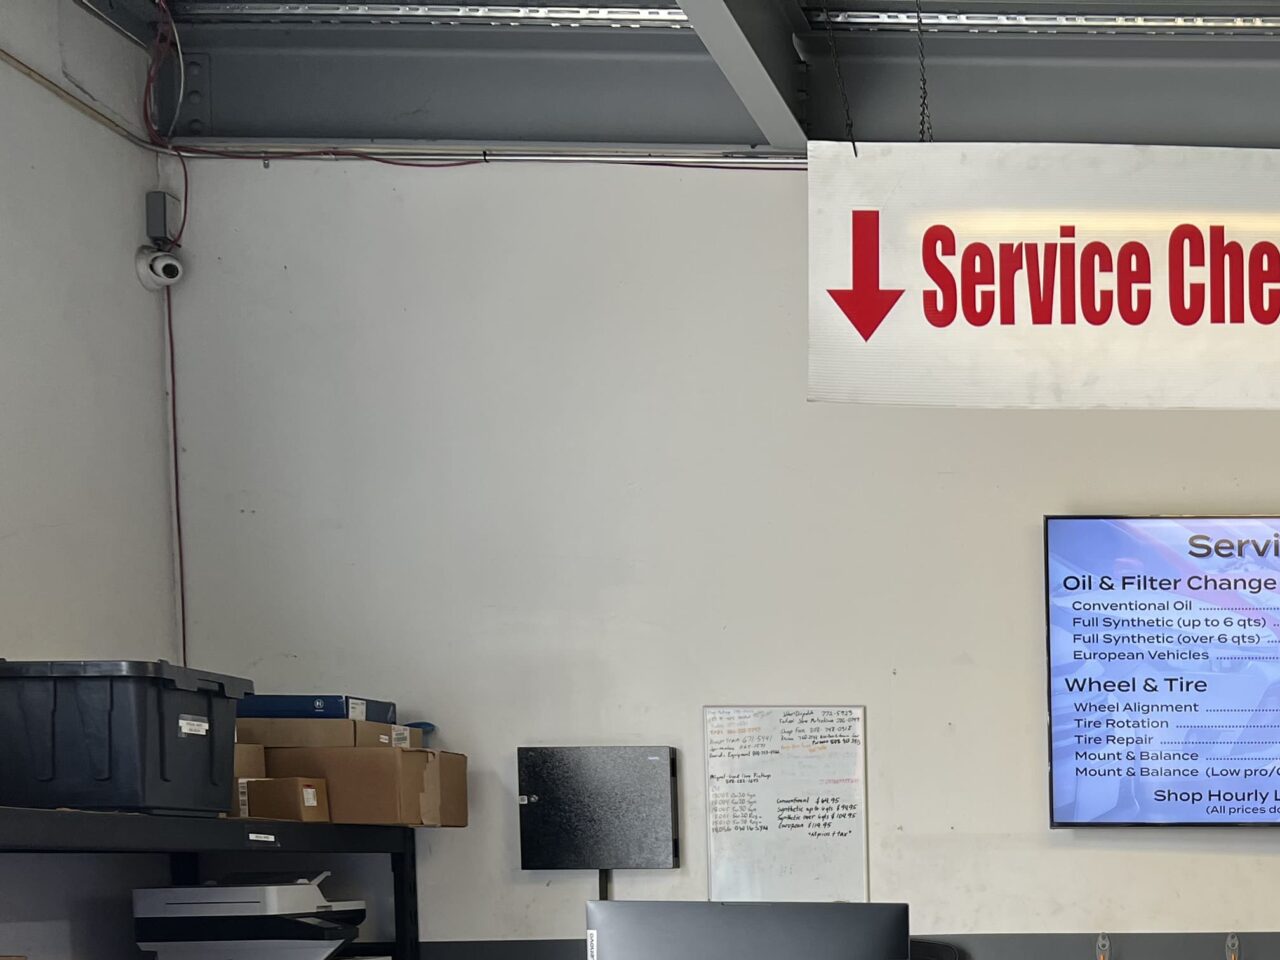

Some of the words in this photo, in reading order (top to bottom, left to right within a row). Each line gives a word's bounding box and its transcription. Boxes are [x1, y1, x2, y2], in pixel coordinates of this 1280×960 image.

[921, 223, 1152, 329] Service
[1063, 576, 1092, 592] Oil
[1099, 576, 1114, 592] &
[1121, 575, 1180, 592] Filter
[1187, 575, 1277, 594] Change
[1072, 601, 1169, 611] Conventional
[1173, 601, 1192, 611] Oil
[1072, 617, 1099, 628] Full
[1102, 617, 1174, 630] Synthetic
[1177, 616, 1201, 630] (up
[1204, 617, 1220, 628] to
[1223, 617, 1234, 628] 6
[1237, 616, 1267, 630] qts)
[1073, 633, 1099, 644] Full
[1102, 633, 1174, 647] Synthetic
[1177, 633, 1214, 646] (over
[1217, 633, 1228, 644] 6
[1231, 633, 1261, 647] qts)
[1073, 650, 1145, 662] European
[1148, 649, 1210, 661] Vehicles
[1065, 677, 1138, 693] Wheel
[1144, 677, 1159, 693] &
[1164, 677, 1208, 693] Tire
[1074, 702, 1119, 713] Wheel
[1123, 702, 1199, 715] Alignment
[1074, 718, 1101, 729] Tire
[1106, 718, 1169, 729] Rotation
[1074, 735, 1101, 745] Tire
[1106, 735, 1154, 748] Repair
[1075, 751, 1121, 761] Mount
[1125, 751, 1136, 761] &
[1140, 751, 1199, 761] Balance
[1075, 767, 1121, 777] Mount
[1125, 767, 1136, 777] &
[1140, 767, 1199, 777] Balance
[1205, 766, 1241, 778] (Low
[1154, 789, 1203, 805] Shop
[1208, 789, 1269, 806] Hourly
[1206, 805, 1226, 816] (All
[1228, 805, 1268, 816] prices
